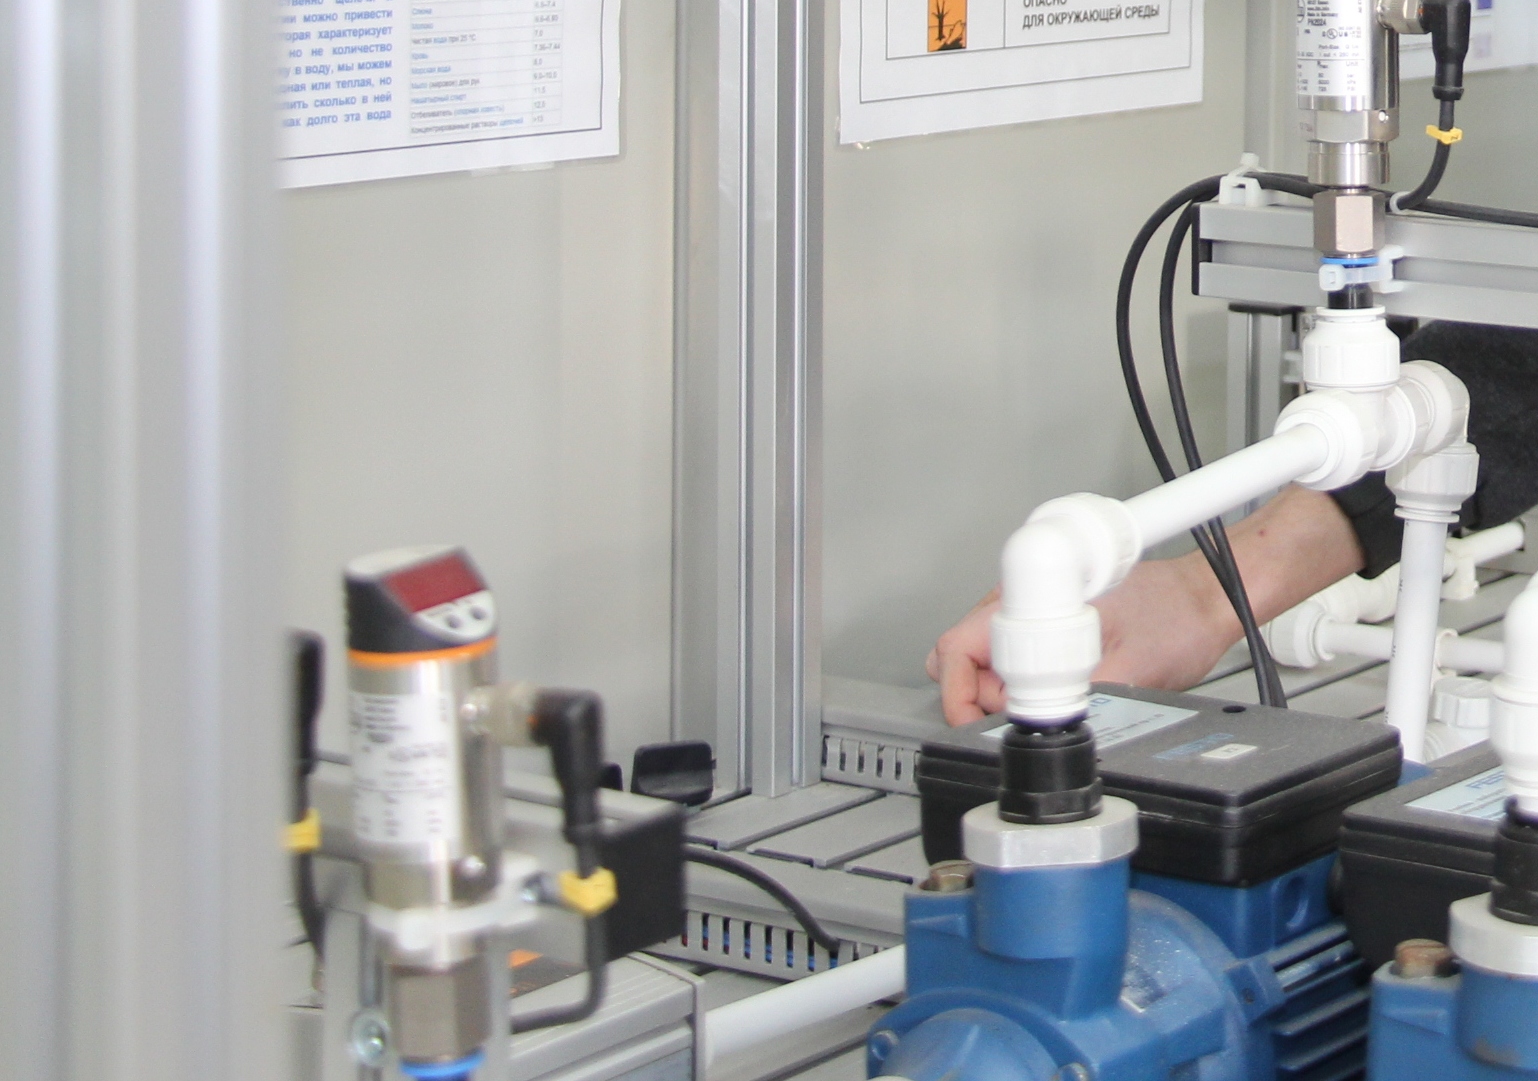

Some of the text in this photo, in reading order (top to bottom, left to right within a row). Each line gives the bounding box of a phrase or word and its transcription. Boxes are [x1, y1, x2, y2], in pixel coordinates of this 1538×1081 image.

[303, 11, 338, 23] можно
[344, 9, 393, 22] привести
[1022, 3, 1160, 30] ДЛЯ ОКРУЖАЮЩЕЙ СРЕДЫ
[317, 25, 393, 41] характеризует
[311, 47, 324, 57] не
[332, 43, 393, 56] количество
[295, 65, 302, 75] в
[305, 63, 334, 76] воду,
[337, 62, 354, 72] мы
[357, 59, 392, 71] можем
[311, 80, 331, 91] или
[336, 77, 375, 89] теплая,
[379, 75, 392, 85] но
[314, 96, 356, 108] сколько
[362, 94, 368, 104] в
[373, 90, 392, 103] ней
[307, 114, 338, 127] долго
[344, 112, 361, 122] эта
[366, 109, 392, 120] вода
